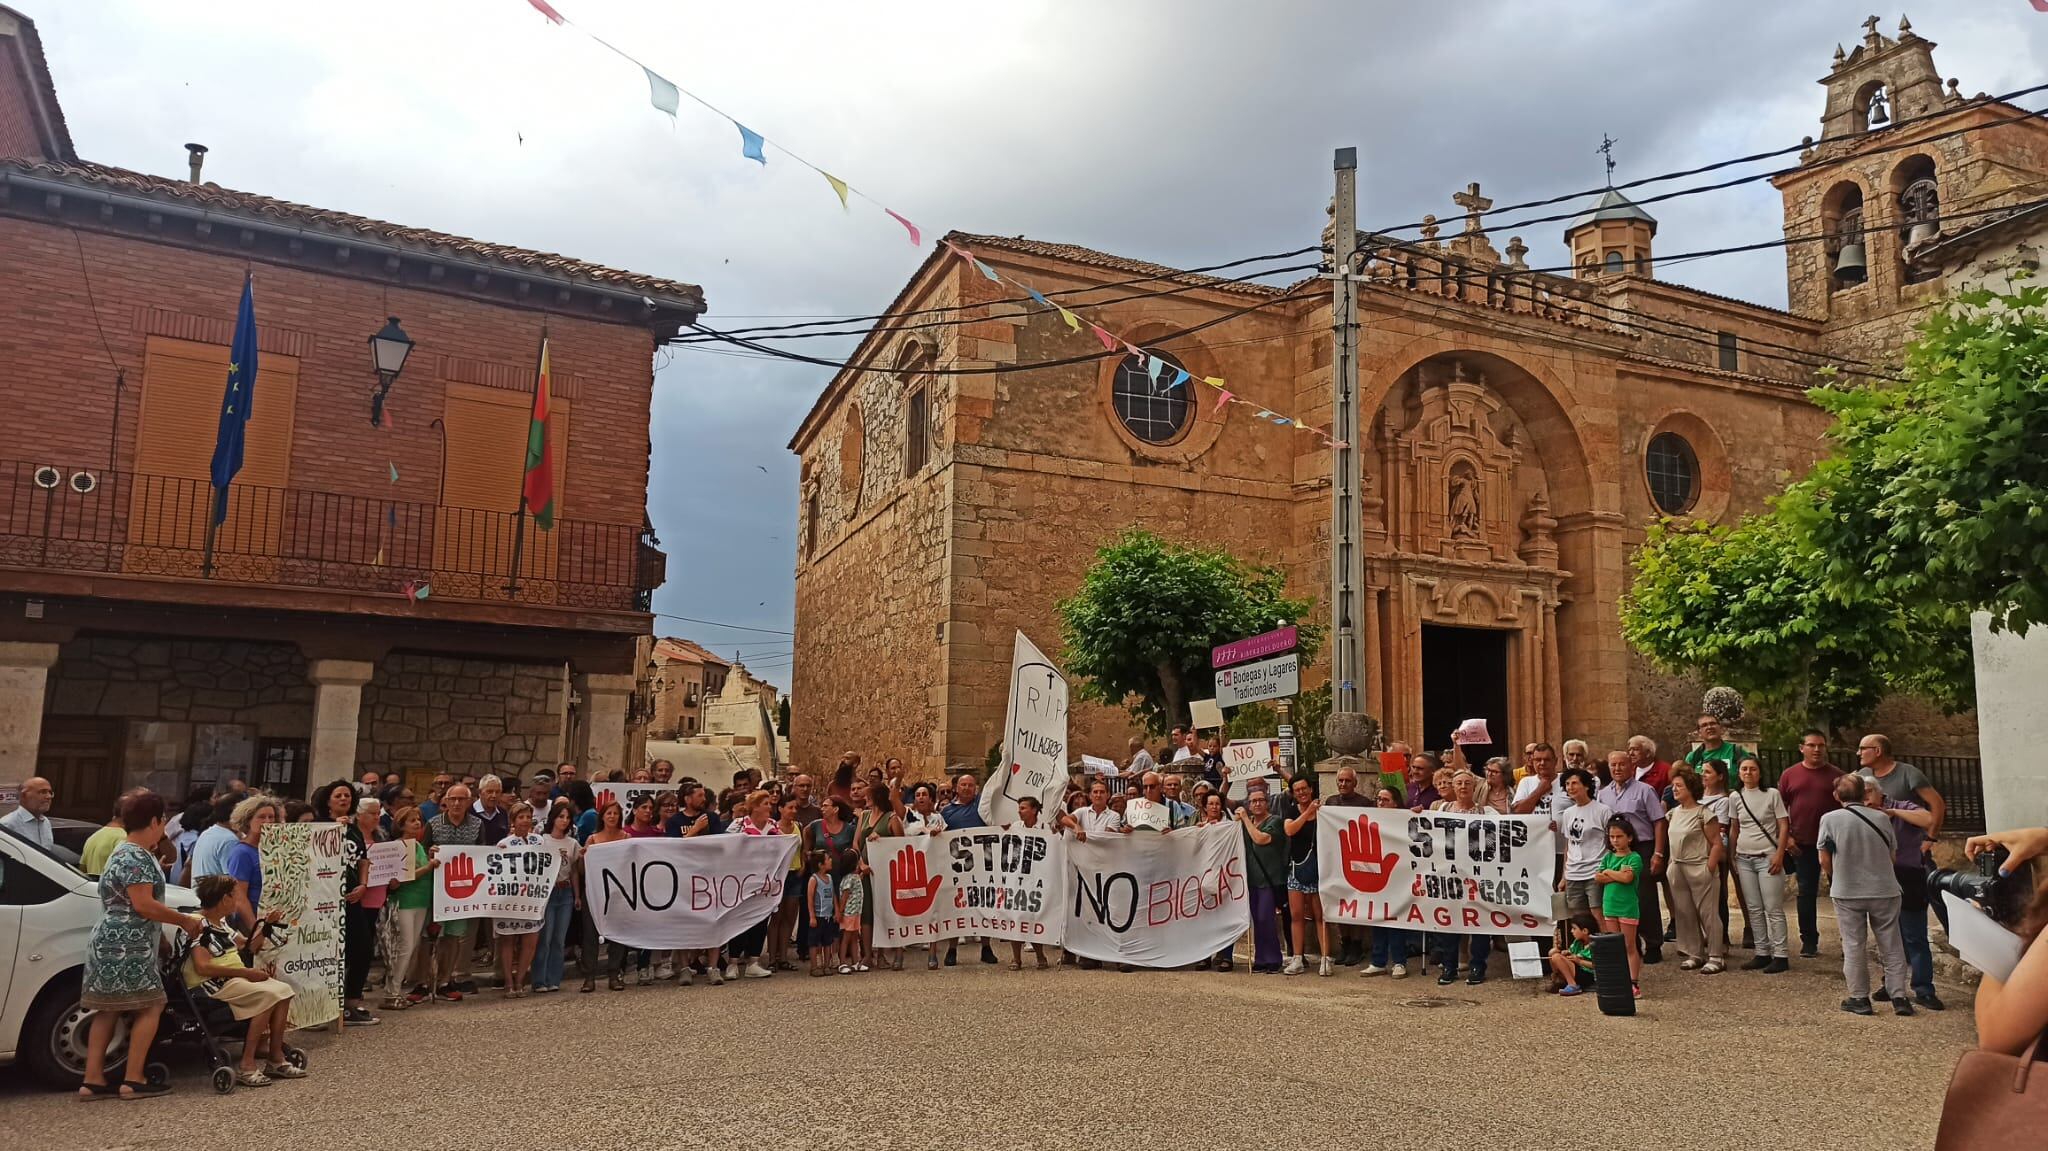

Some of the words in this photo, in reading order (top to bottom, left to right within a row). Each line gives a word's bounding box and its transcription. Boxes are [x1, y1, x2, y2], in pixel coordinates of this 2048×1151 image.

[1233, 669, 1261, 685] Bodegas
[1263, 667, 1268, 681] y
[1268, 661, 1297, 678] Lagares
[1233, 681, 1277, 700] Tradicionales
[1232, 746, 1254, 761] NO
[1135, 801, 1152, 810] NO
[1407, 816, 1528, 863] STOP
[486, 851, 553, 876] STOP
[949, 834, 1047, 875] STOP
[488, 876, 550, 884] PLANTA
[953, 875, 1044, 889] PLANTA
[1411, 861, 1529, 878] PLANTA
[602, 860, 678, 916] NO
[691, 873, 782, 911] BIOGAS
[954, 886, 1043, 913] ¿BIO?GAS
[1074, 864, 1139, 934] NO
[1148, 857, 1245, 927] BIOGAS
[1411, 874, 1530, 906] ¿BIO?GAS
[444, 903, 540, 914] FUENTELCÉSPE
[1338, 898, 1539, 929] MILAGROS
[887, 915, 1045, 940] FUENTELCÉSPED
